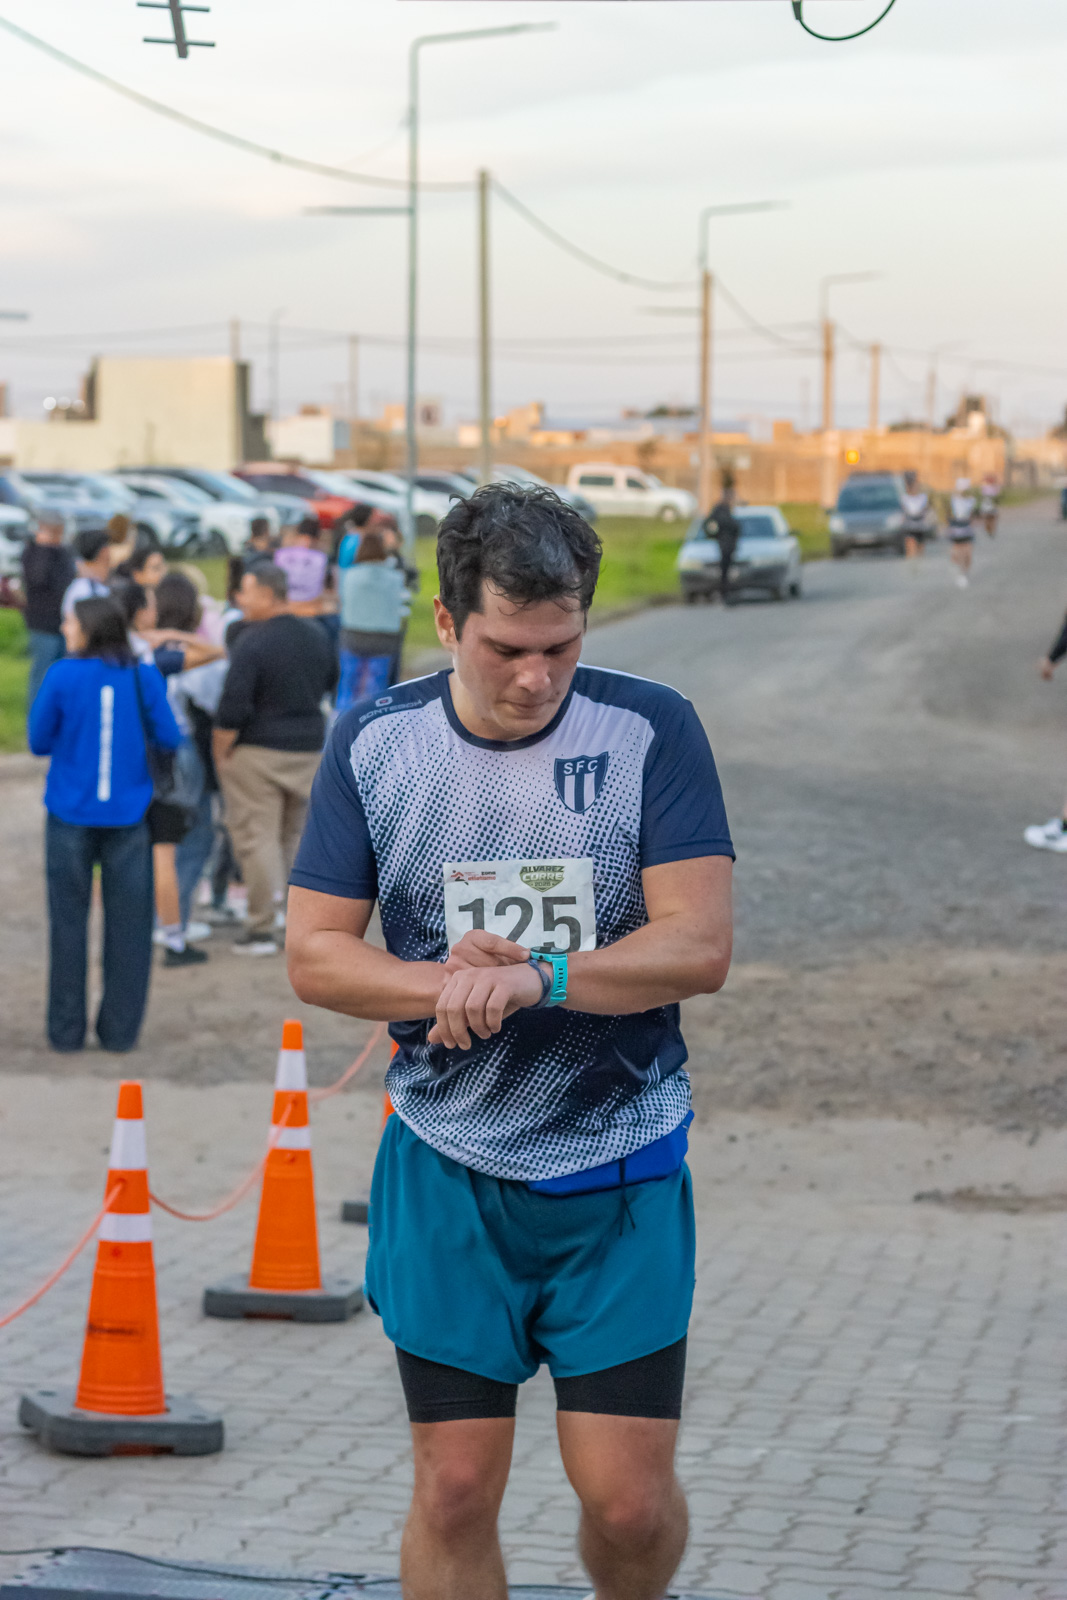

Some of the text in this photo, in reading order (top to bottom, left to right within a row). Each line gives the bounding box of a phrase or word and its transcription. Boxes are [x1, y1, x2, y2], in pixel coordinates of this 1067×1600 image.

[563, 760, 598, 775] SFC
[522, 872, 564, 881] CORRE
[458, 896, 581, 952] 125
